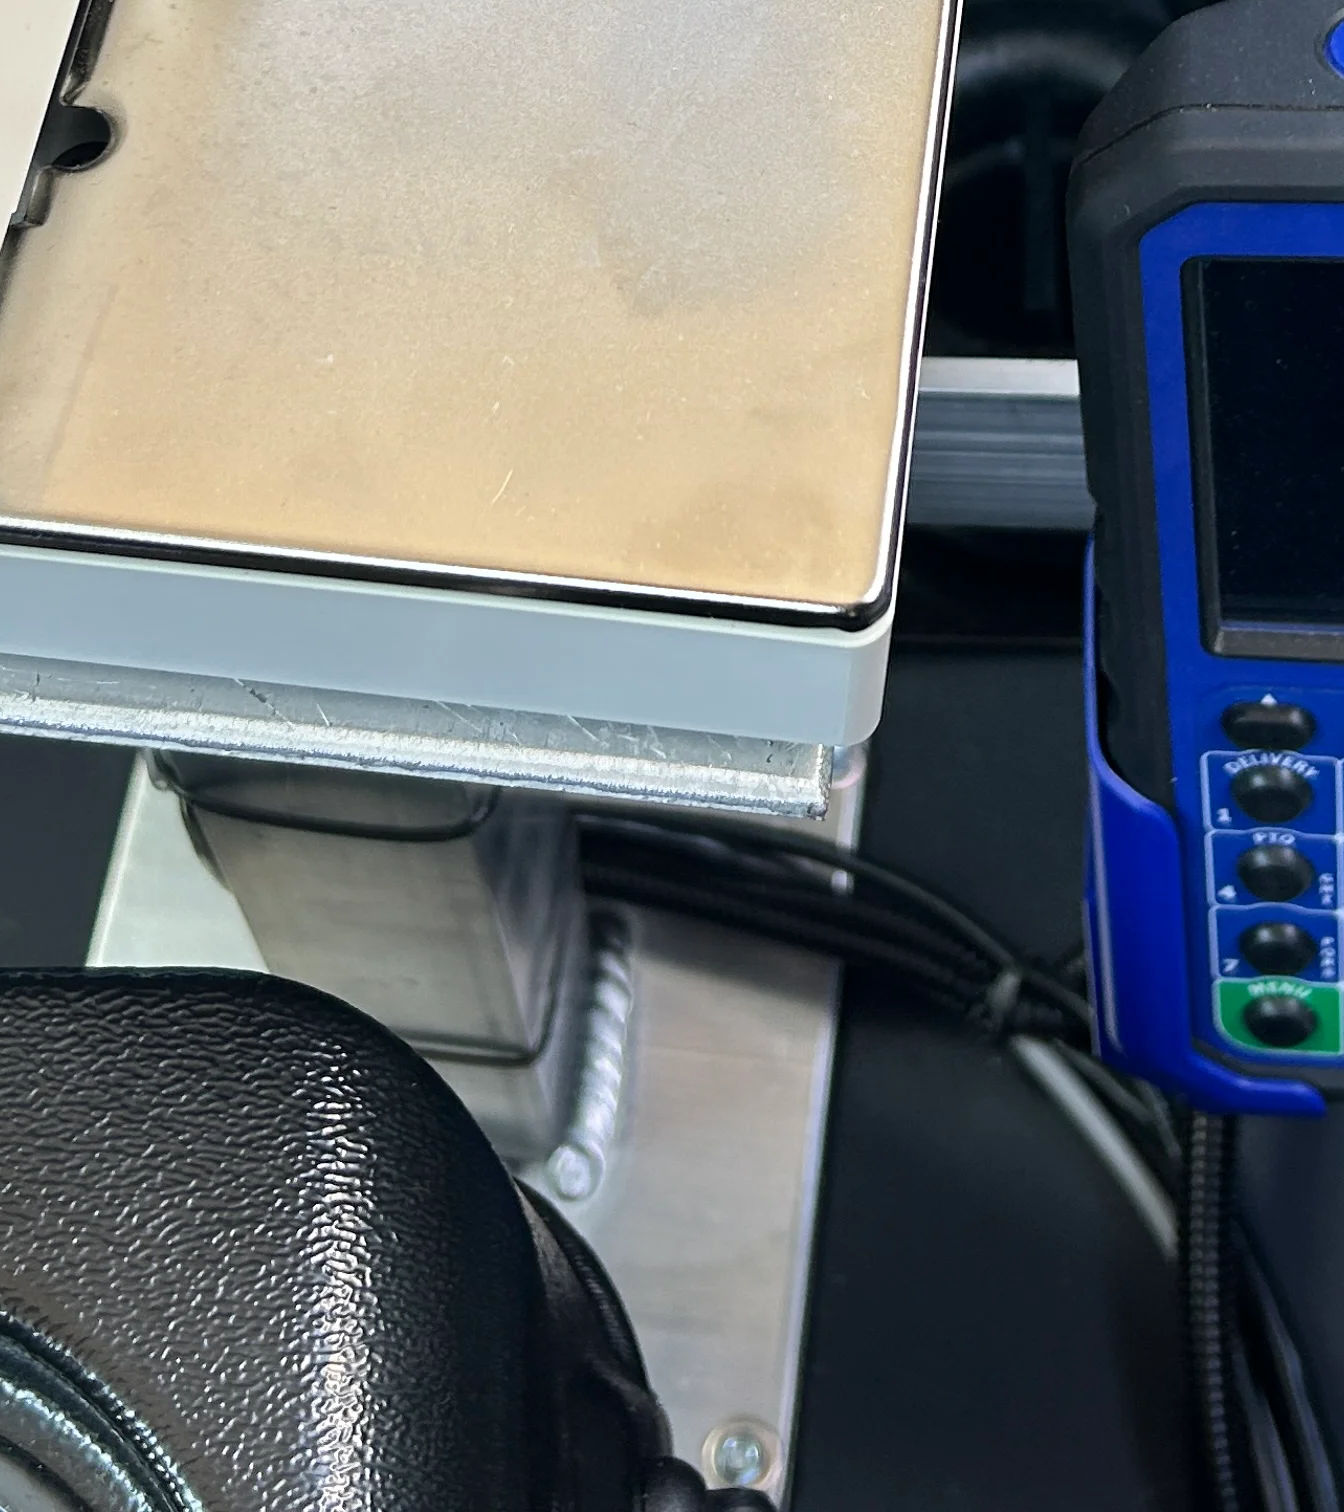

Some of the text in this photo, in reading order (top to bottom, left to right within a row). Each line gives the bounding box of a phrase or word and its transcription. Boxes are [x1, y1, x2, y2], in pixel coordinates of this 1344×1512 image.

[1223, 752, 1320, 779] DELIVERY
[1217, 807, 1232, 824] 1
[1253, 831, 1296, 845] PTO
[1217, 884, 1237, 901] 4
[1222, 958, 1240, 973] 7
